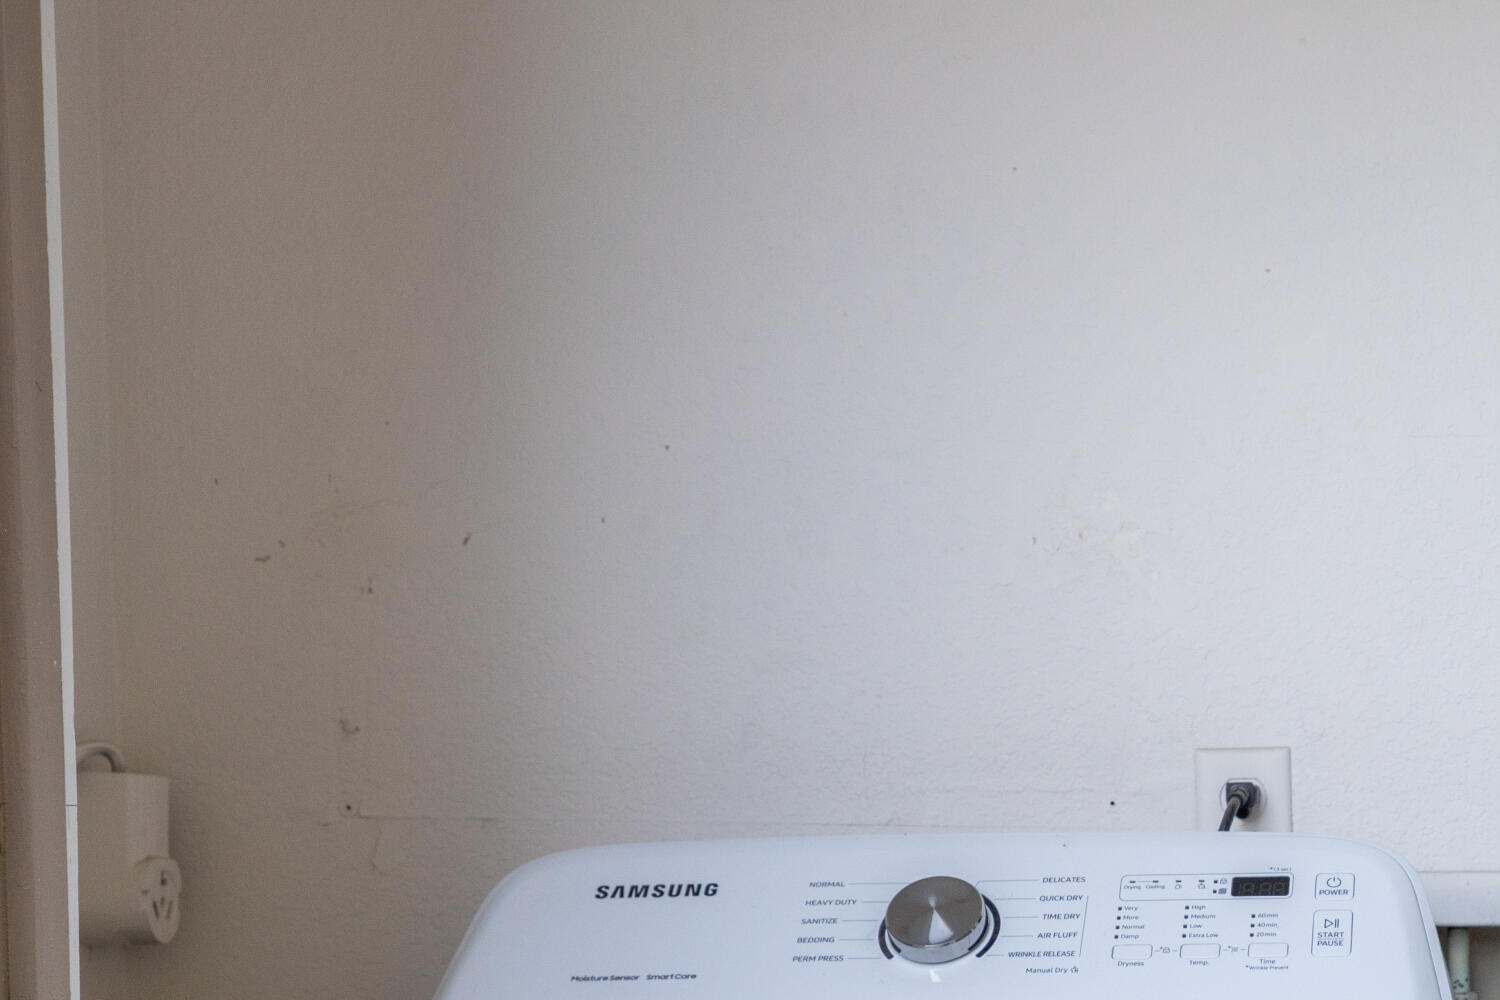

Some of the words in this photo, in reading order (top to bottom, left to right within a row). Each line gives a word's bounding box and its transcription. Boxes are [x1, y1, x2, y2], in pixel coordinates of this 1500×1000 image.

[594, 883, 719, 900] SAMSUNG
[796, 936, 835, 944] BEDDING
[1054, 966, 1068, 975] Dry
[570, 974, 608, 982] Moisture
[609, 973, 640, 981] Sensor
[645, 972, 674, 981] Smart
[674, 971, 697, 980] Care
